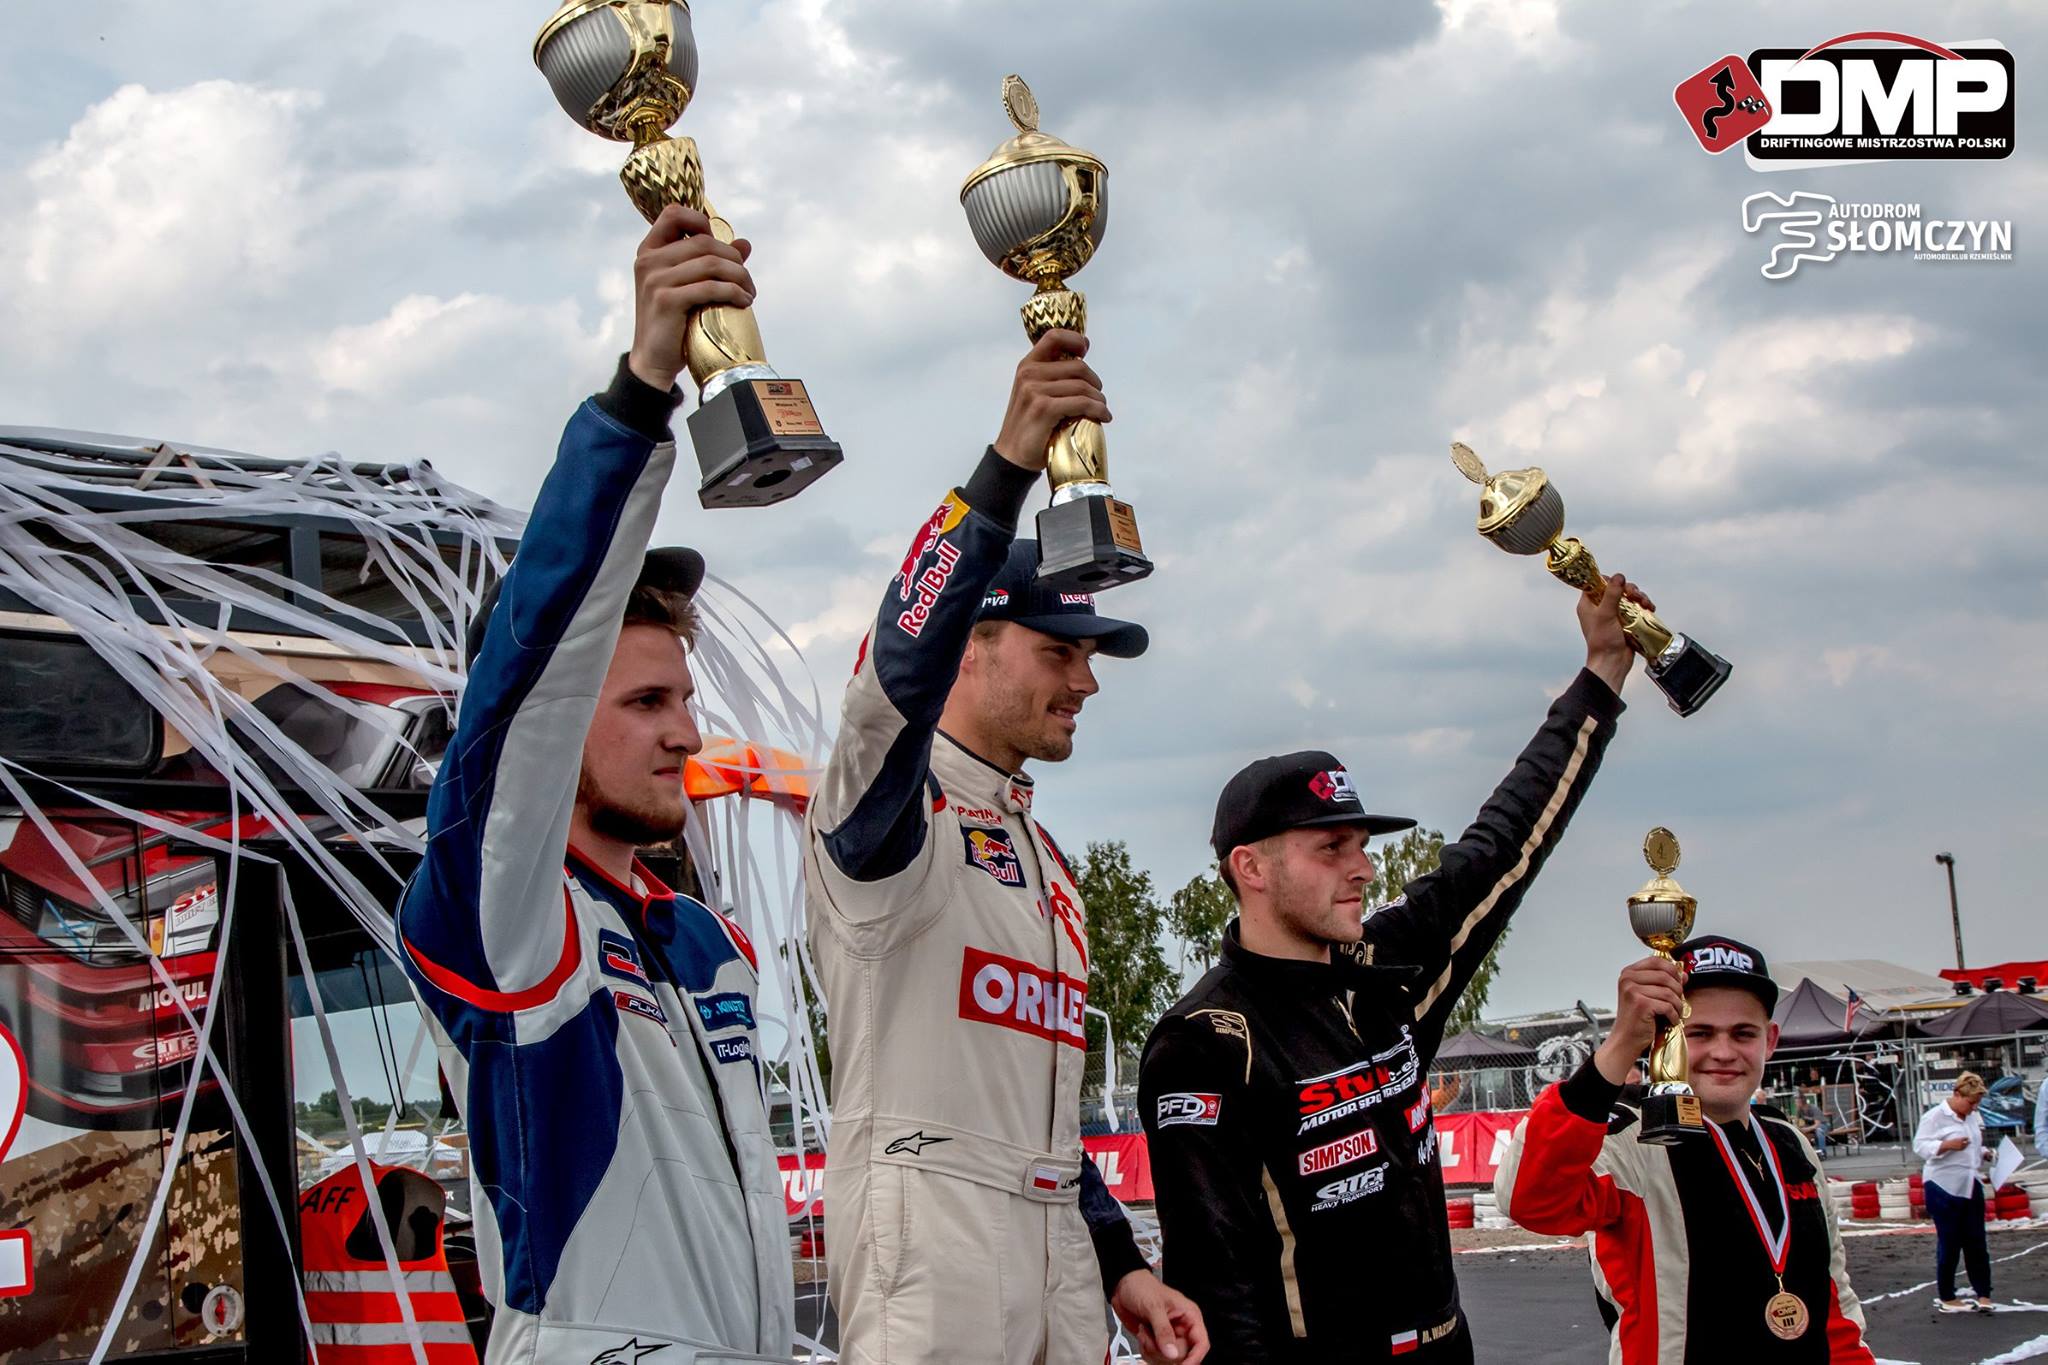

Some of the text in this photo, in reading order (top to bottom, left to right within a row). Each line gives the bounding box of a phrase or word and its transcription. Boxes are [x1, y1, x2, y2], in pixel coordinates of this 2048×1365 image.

[1693, 947, 1754, 970] DMP
[1303, 1131, 1372, 1173] SIMPSON
[1311, 1200, 1339, 1212] HEAVY
